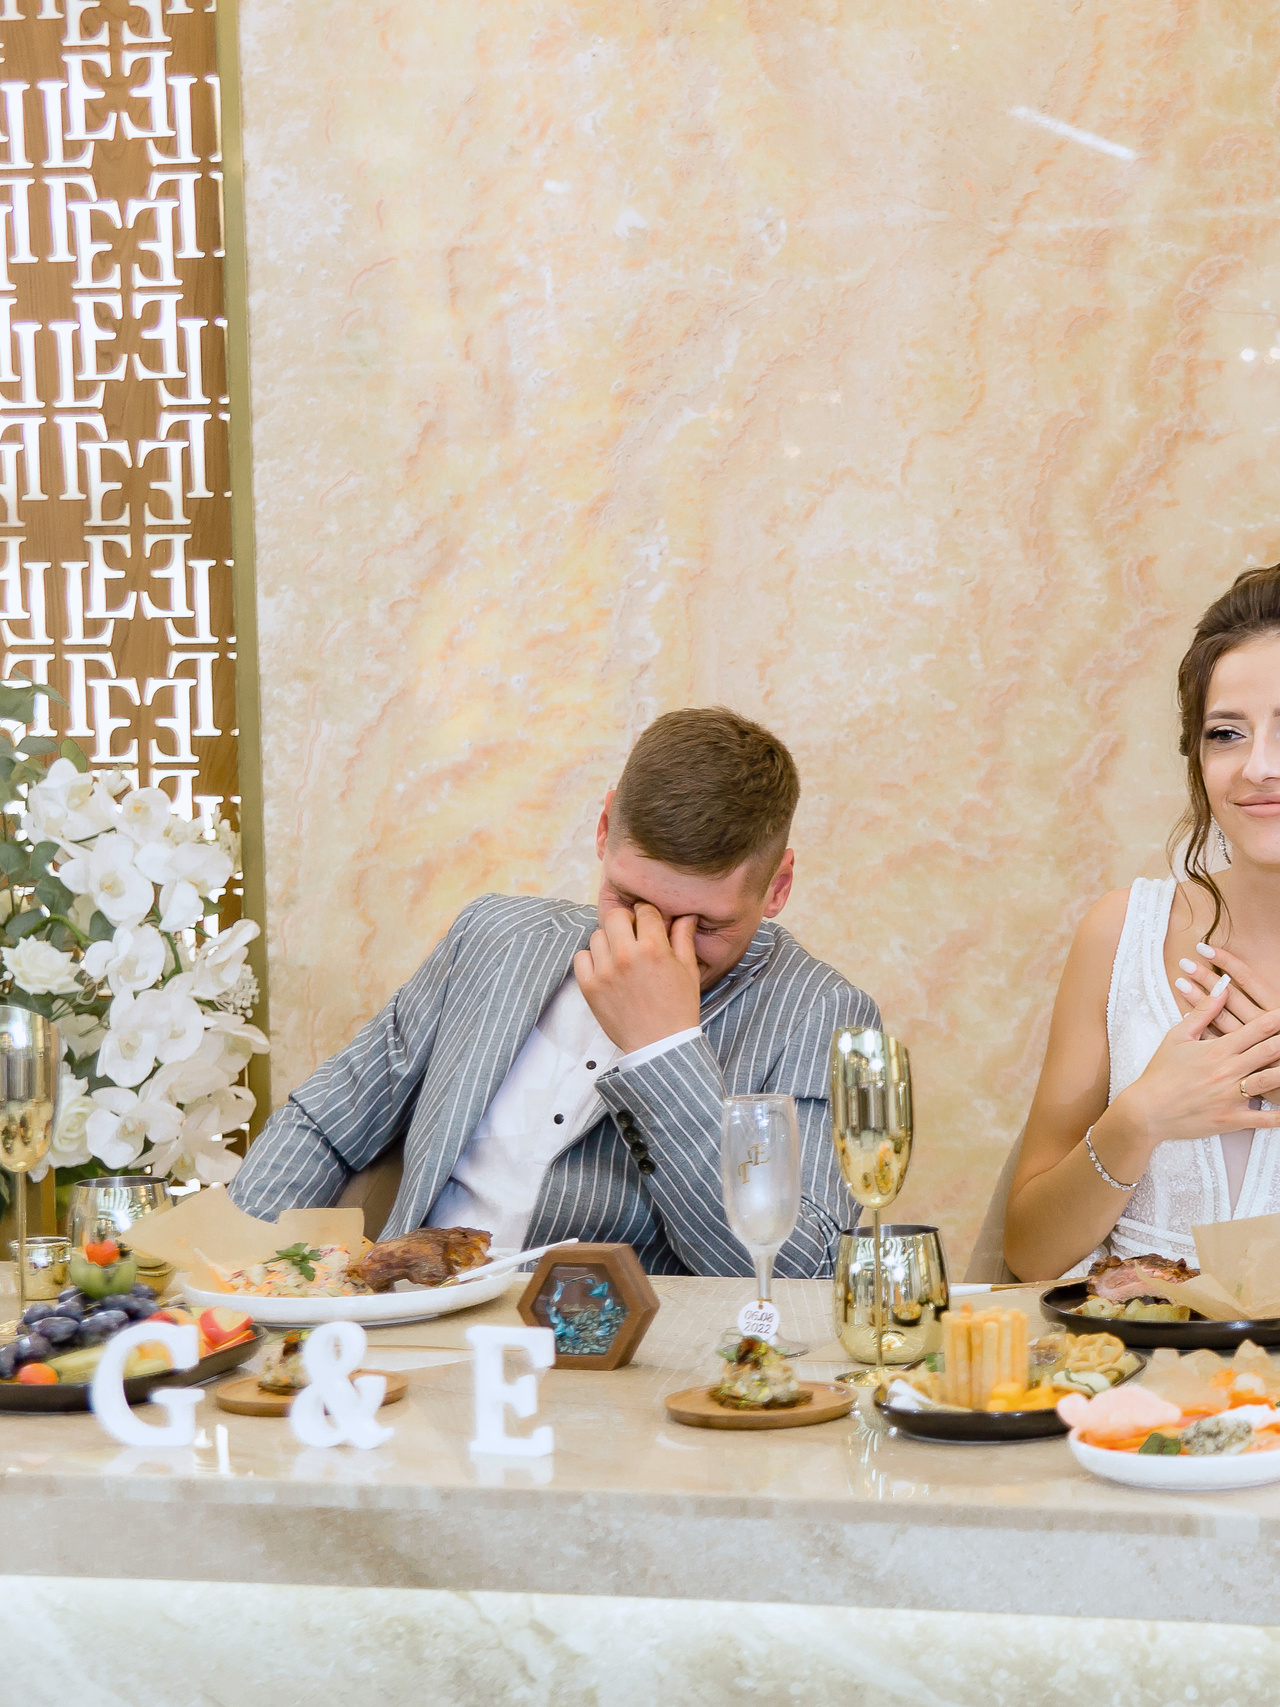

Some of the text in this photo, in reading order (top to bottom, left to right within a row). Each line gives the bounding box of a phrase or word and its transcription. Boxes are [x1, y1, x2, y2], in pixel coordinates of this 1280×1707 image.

[743, 1321, 771, 1334] 2022
[92, 1321, 555, 1457] G & E
